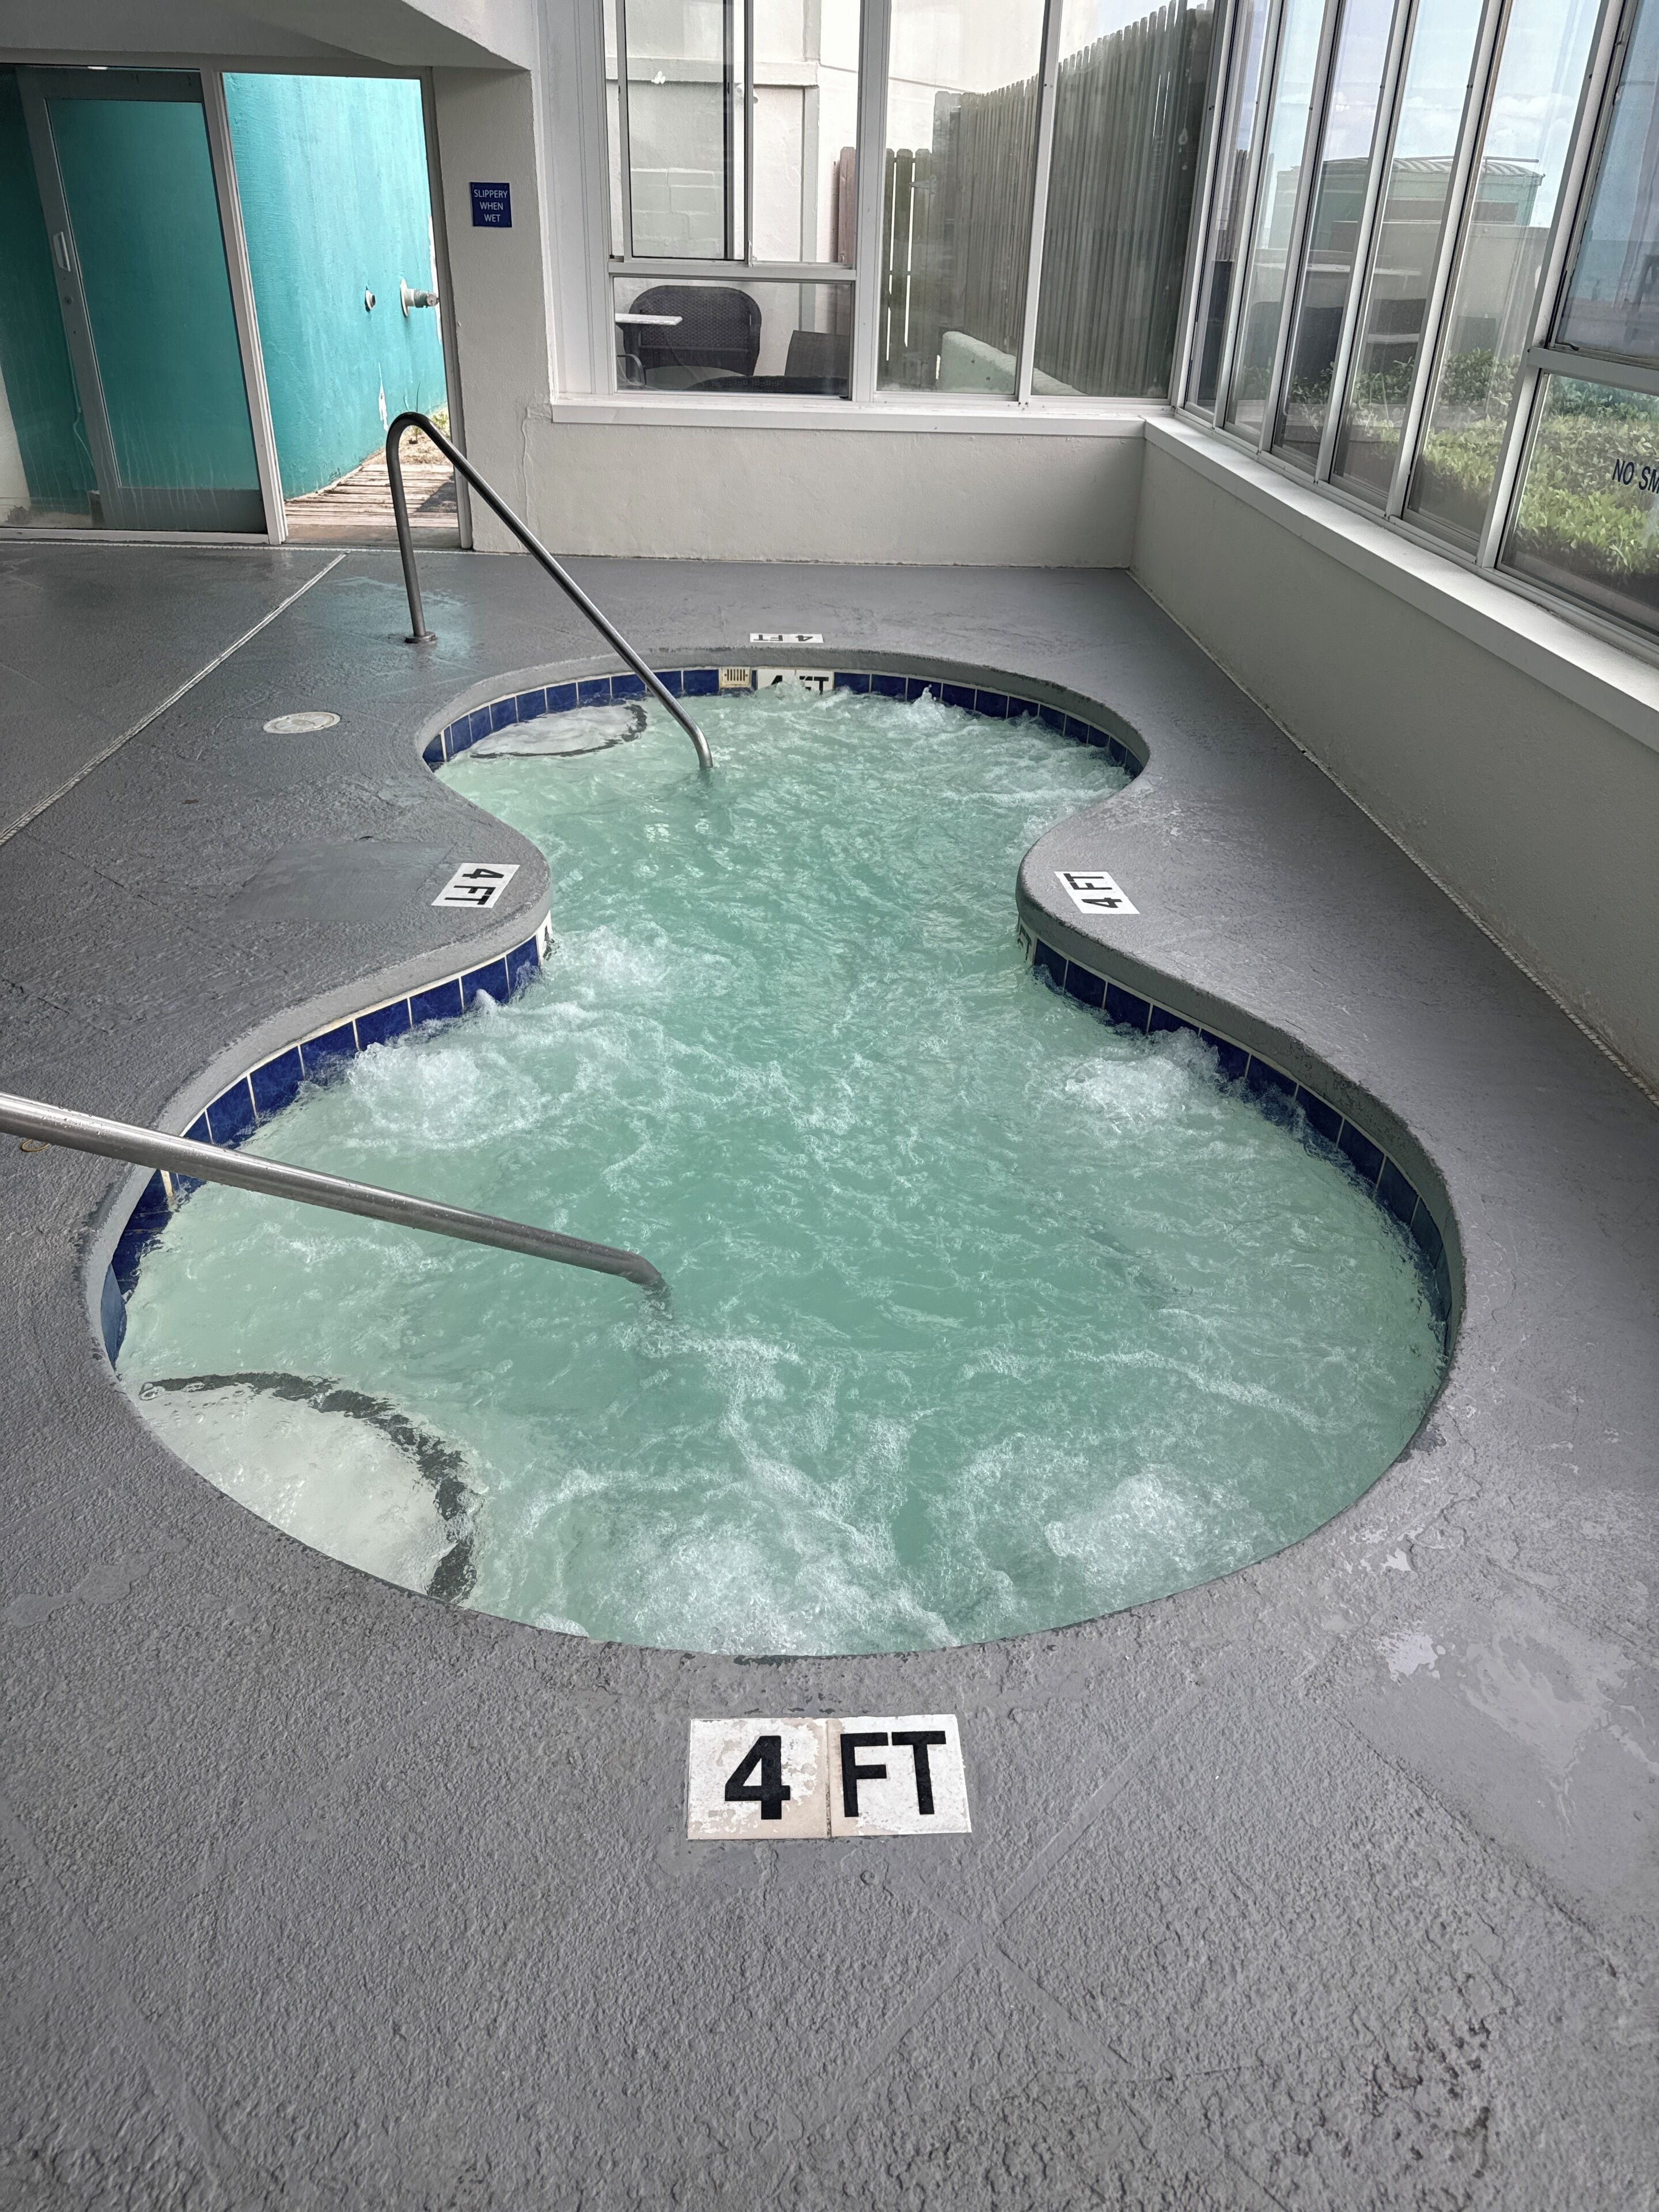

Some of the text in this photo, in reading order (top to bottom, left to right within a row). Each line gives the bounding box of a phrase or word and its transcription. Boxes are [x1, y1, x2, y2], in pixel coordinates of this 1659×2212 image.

[474, 189, 508, 199] SLIPPERY
[479, 202, 504, 210] WHEN
[484, 213, 501, 222] WET
[1612, 459, 1635, 485] NO
[444, 868, 505, 905] 4 FT
[1063, 873, 1123, 908] 4 FT
[724, 1730, 947, 1820] 4 FT
